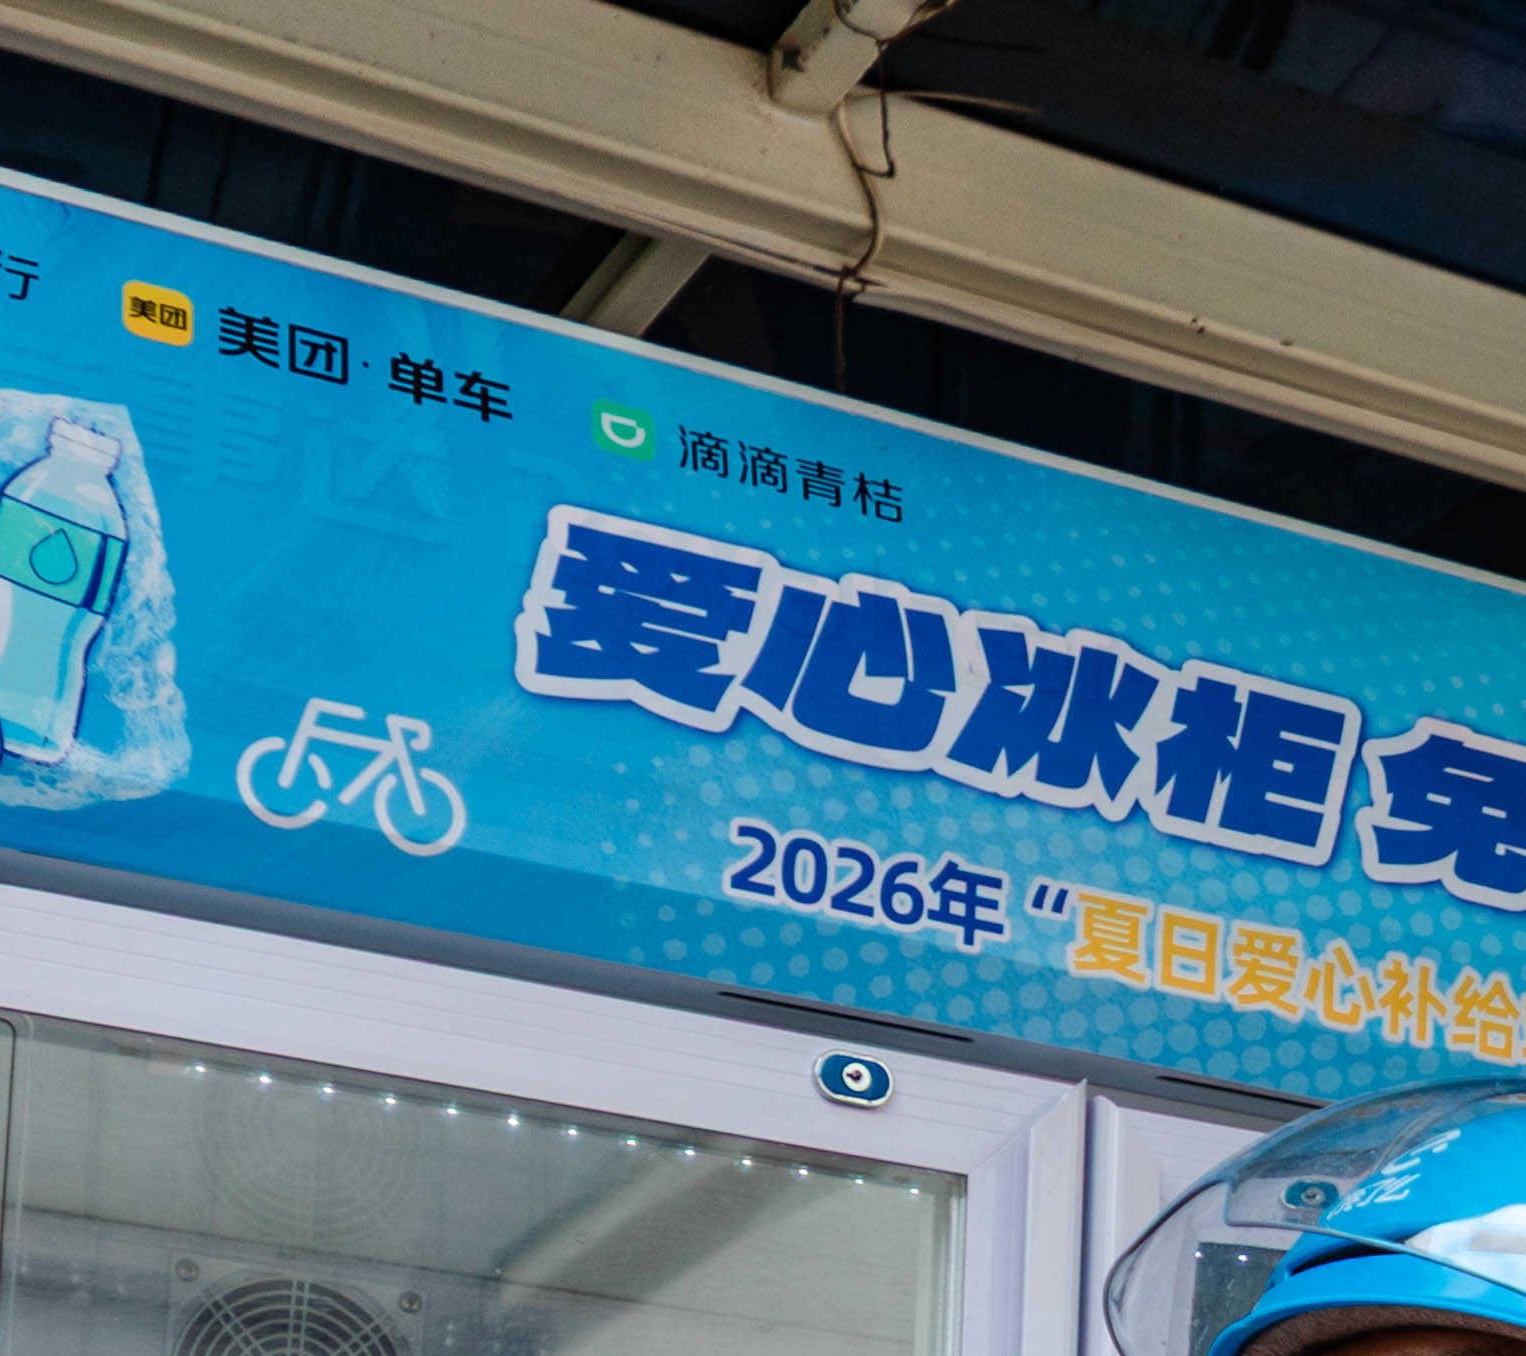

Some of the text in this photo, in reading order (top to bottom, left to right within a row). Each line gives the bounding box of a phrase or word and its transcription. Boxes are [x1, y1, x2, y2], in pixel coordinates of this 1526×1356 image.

[127, 293, 189, 332] 美团
[677, 423, 906, 526] 滴滴青桔
[532, 520, 1349, 852] 爱心冰柜
